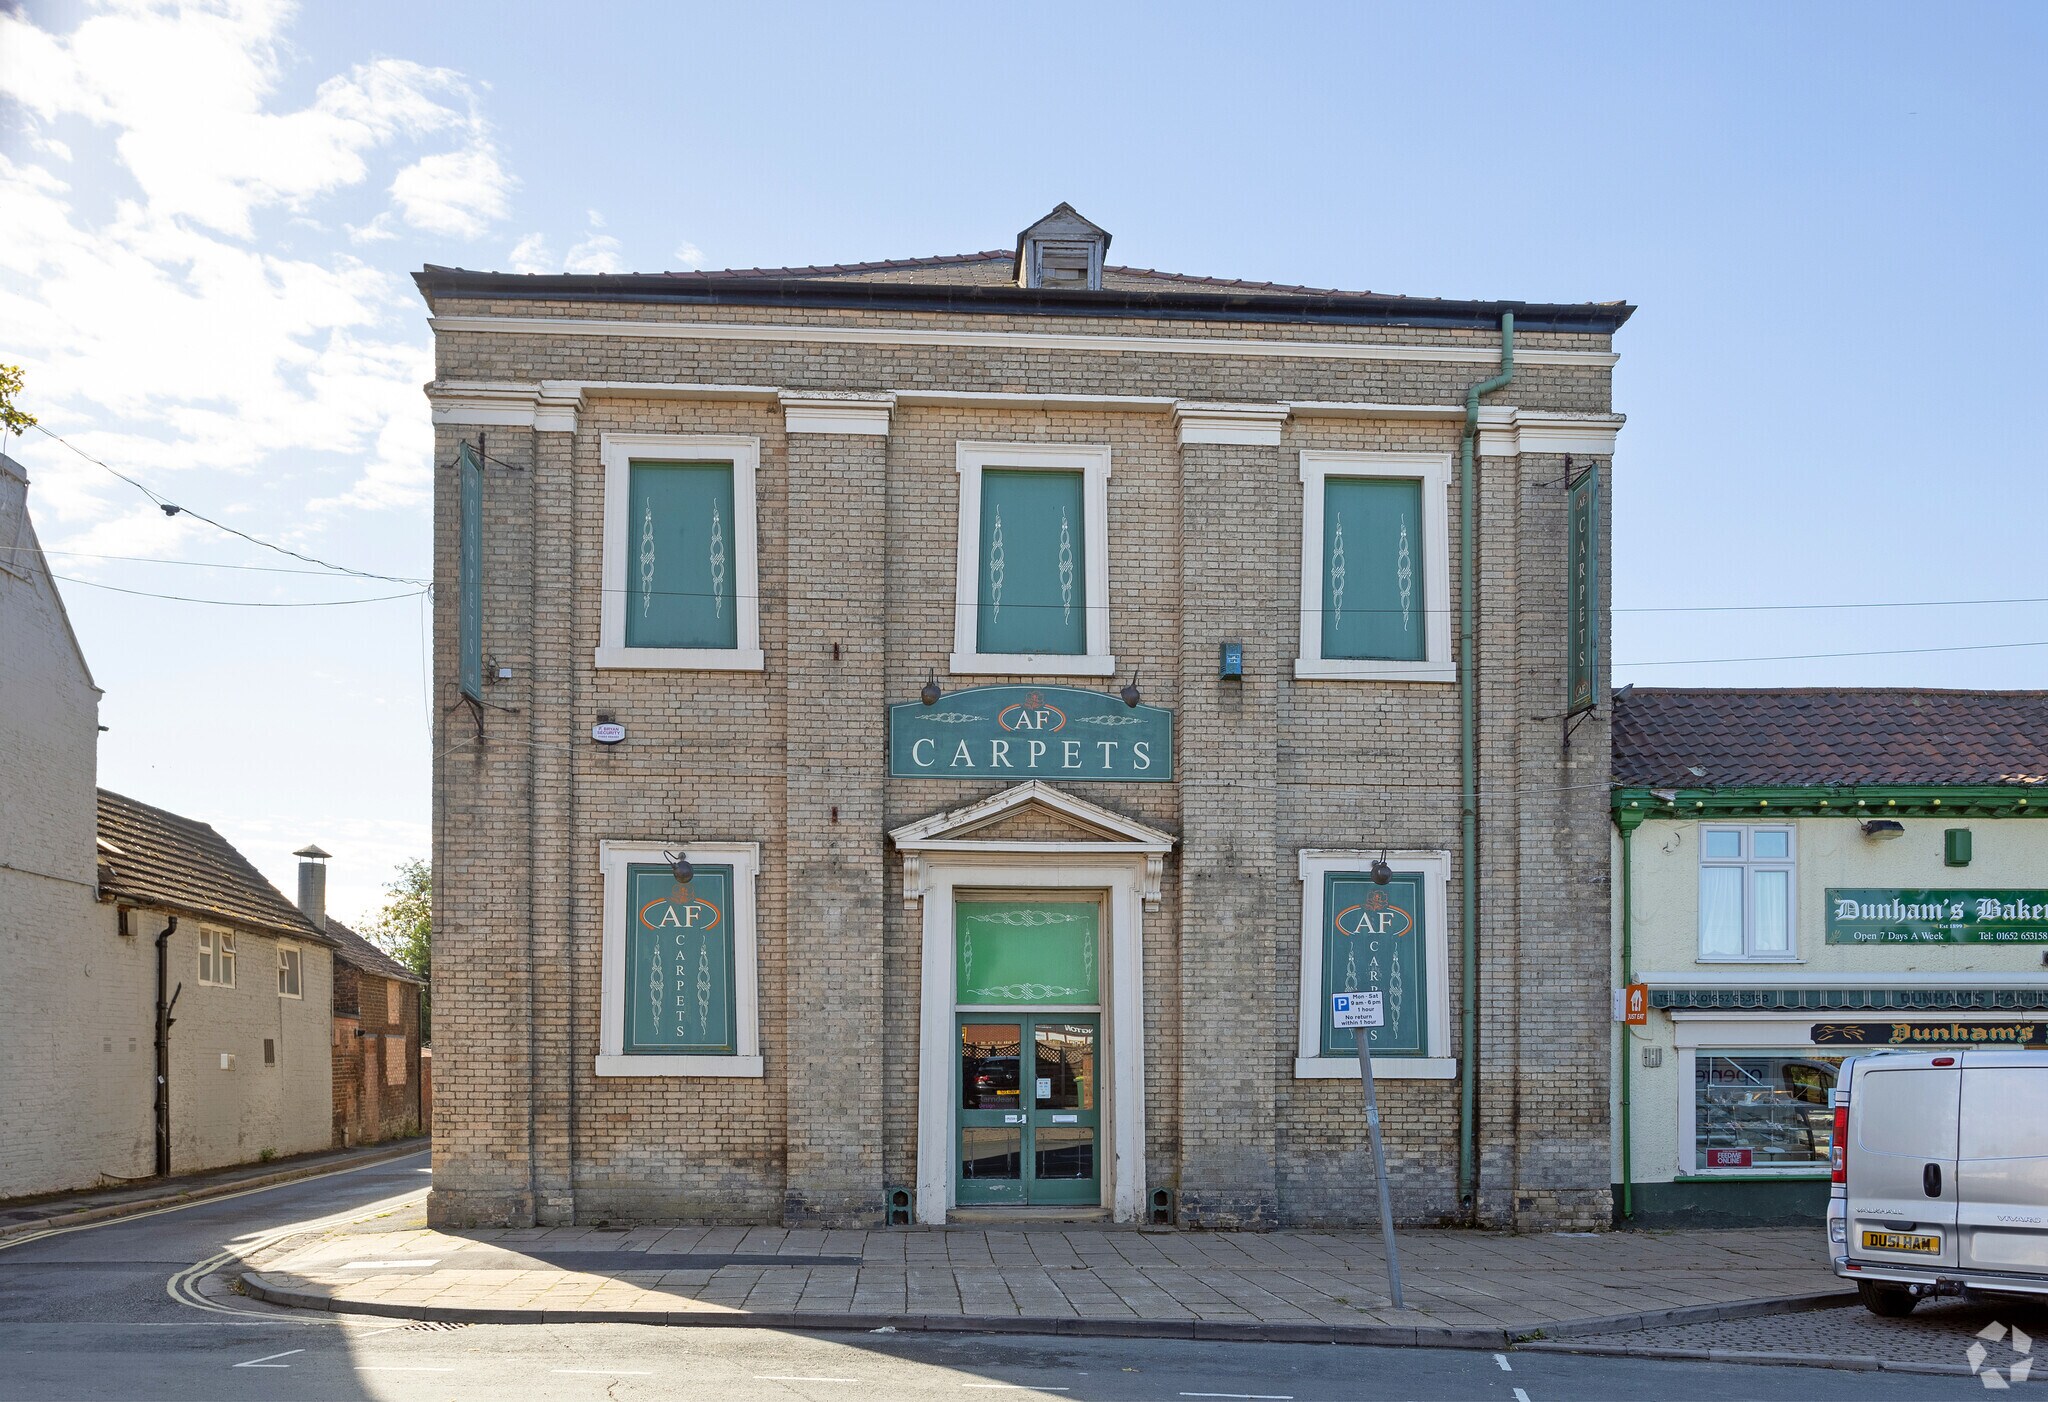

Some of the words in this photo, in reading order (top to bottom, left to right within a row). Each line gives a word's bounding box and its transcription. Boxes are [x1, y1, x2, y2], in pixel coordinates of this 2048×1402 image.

[1578, 516, 1586, 668] CARPETS
[1014, 710, 1051, 730] AF
[912, 738, 1152, 770] CARPETS
[659, 905, 702, 927] AF
[1834, 898, 1965, 924] Dunham's
[1354, 912, 1395, 934] AF
[1854, 931, 1877, 941] Open
[1880, 931, 1885, 940] 7
[1888, 931, 1908, 942] Days
[1911, 931, 1919, 940] A
[1922, 931, 1944, 940] Week
[1979, 931, 1994, 940] Tel:
[1996, 931, 2018, 940] 01652
[2020, 931, 2048, 940] 653158
[675, 934, 686, 1037] CARPETS
[1338, 998, 1347, 1010] P
[1888, 1023, 2035, 1044] Dunham's
[1855, 1207, 1904, 1215] VAUXHALL
[1997, 1215, 2041, 1224] VIVARO
